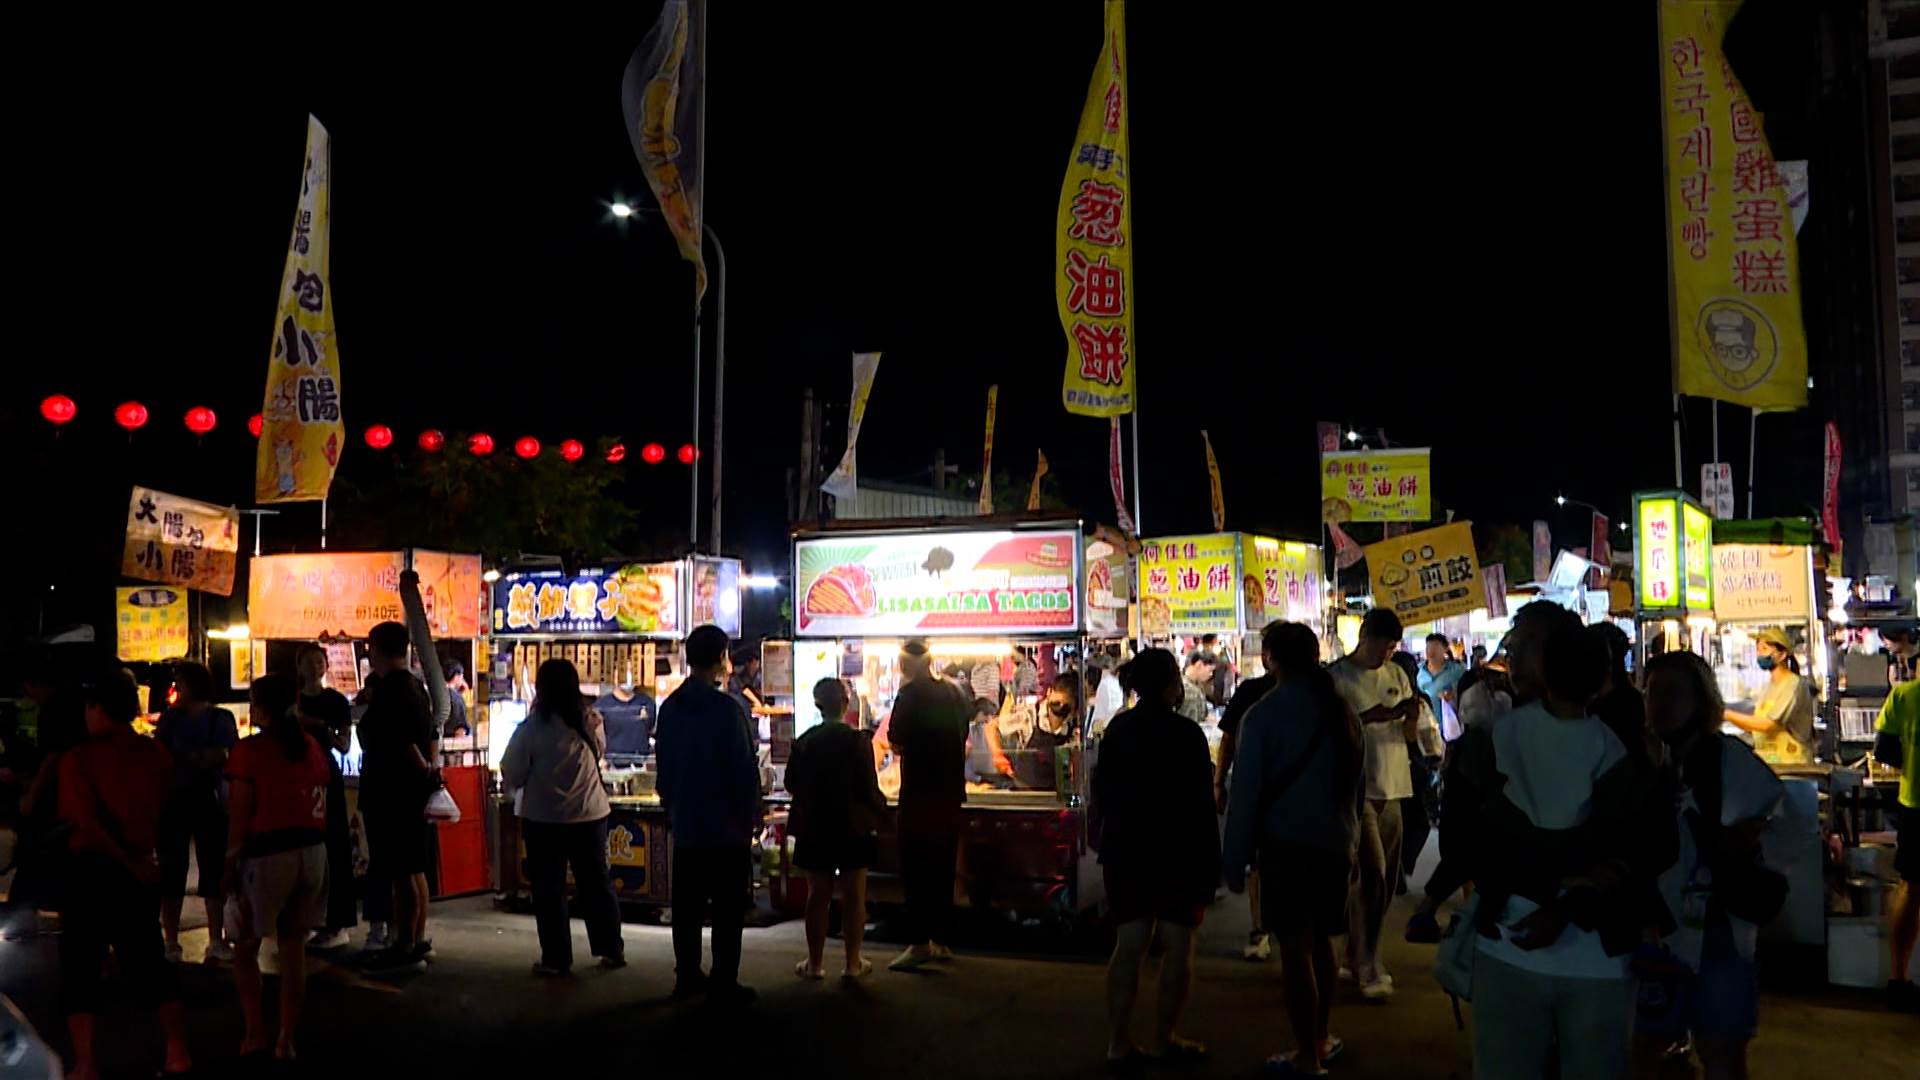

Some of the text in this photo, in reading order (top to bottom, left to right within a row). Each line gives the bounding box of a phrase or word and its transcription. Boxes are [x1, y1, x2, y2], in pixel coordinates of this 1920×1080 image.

[1671, 36, 1714, 261] 한국계란빵
[135, 540, 196, 580] 小腸
[878, 590, 1071, 614] LISASALSA TACOS
